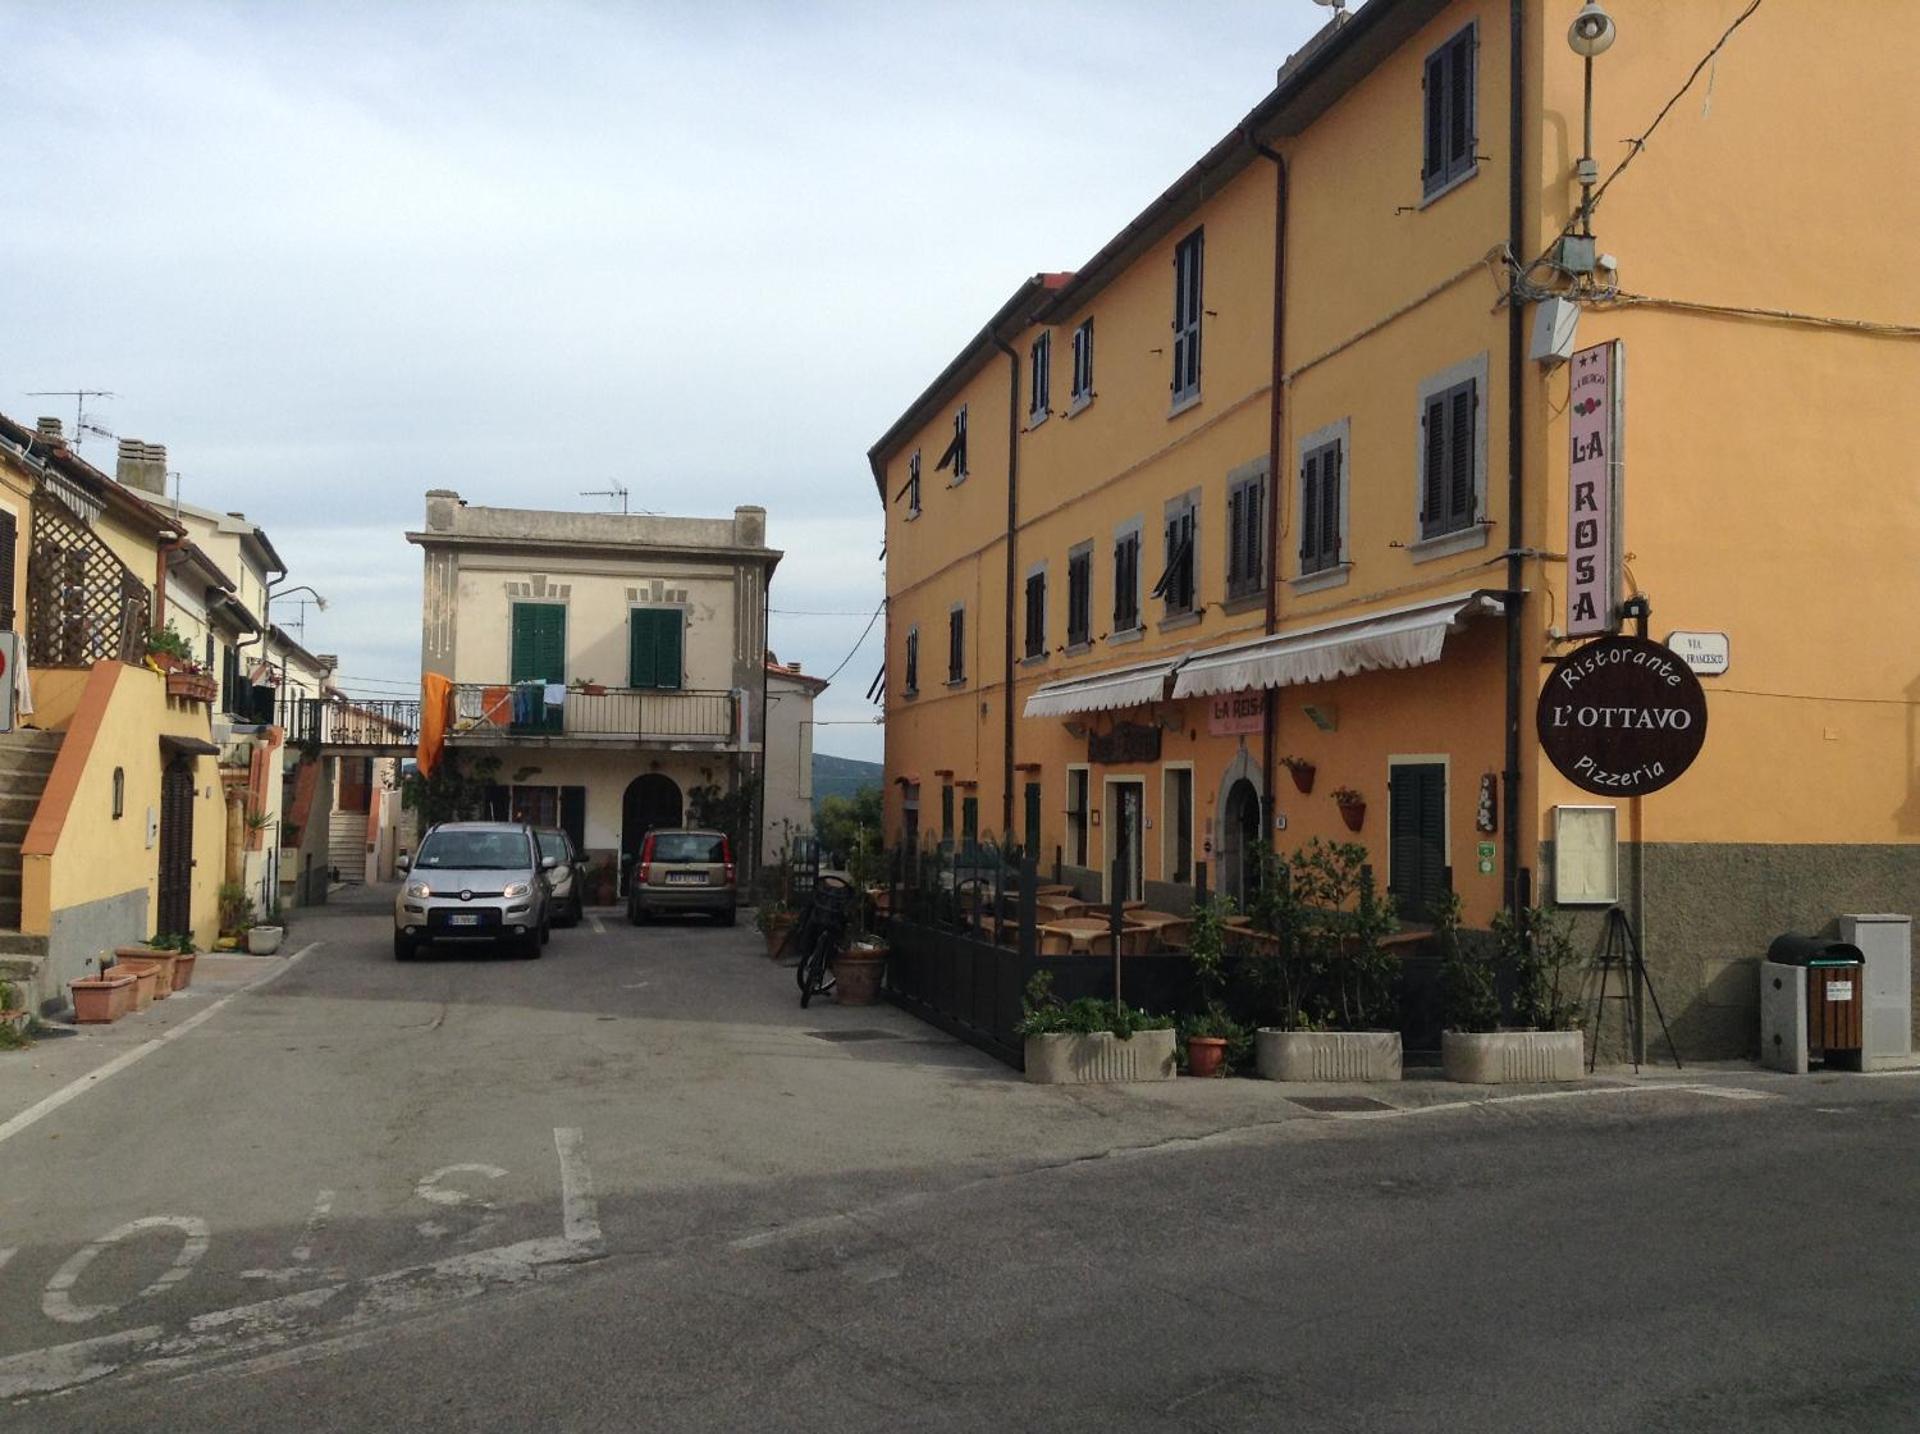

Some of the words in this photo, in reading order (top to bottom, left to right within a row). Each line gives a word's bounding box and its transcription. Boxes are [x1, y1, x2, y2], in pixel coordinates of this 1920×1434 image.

[1573, 373, 1605, 391] BERGO
[1573, 431, 1603, 464] LA
[1573, 481, 1598, 621] ROSA
[1687, 638, 1703, 649] VIA
[1560, 648, 1681, 690] Ristorante
[1214, 701, 1229, 719] LA
[1553, 705, 1692, 730] L'OTTAVO
[1574, 755, 1665, 787] Pizzeria
